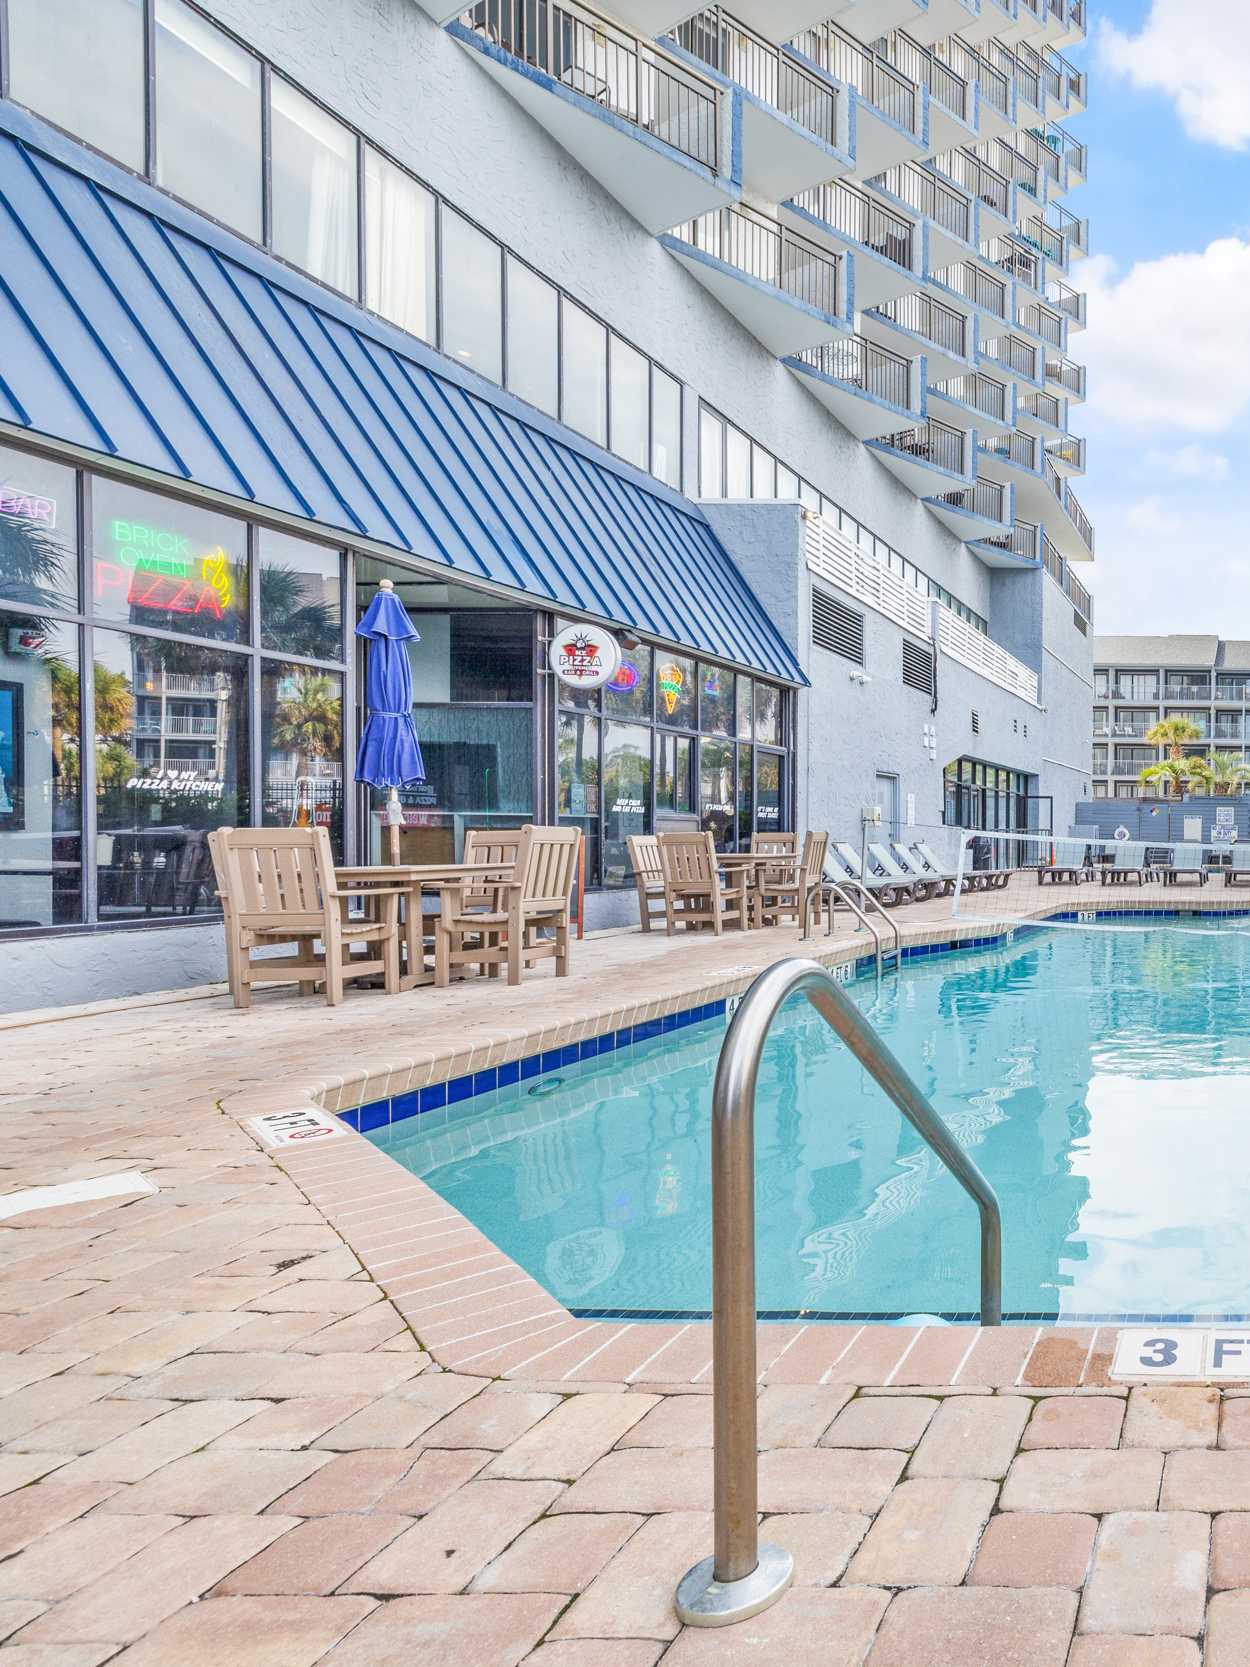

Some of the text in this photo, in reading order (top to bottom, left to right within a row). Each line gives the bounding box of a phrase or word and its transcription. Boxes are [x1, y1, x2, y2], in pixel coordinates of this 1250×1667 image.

[113, 520, 190, 554] BRICK
[119, 546, 187, 578] OVEN
[95, 562, 224, 621] PIZZA
[560, 655, 602, 666] PIZZA
[127, 778, 224, 792] PIZZA KITCHEN
[180, 771, 198, 780] NY
[1087, 912, 1096, 921] FT
[1139, 1338, 1179, 1367] 3
